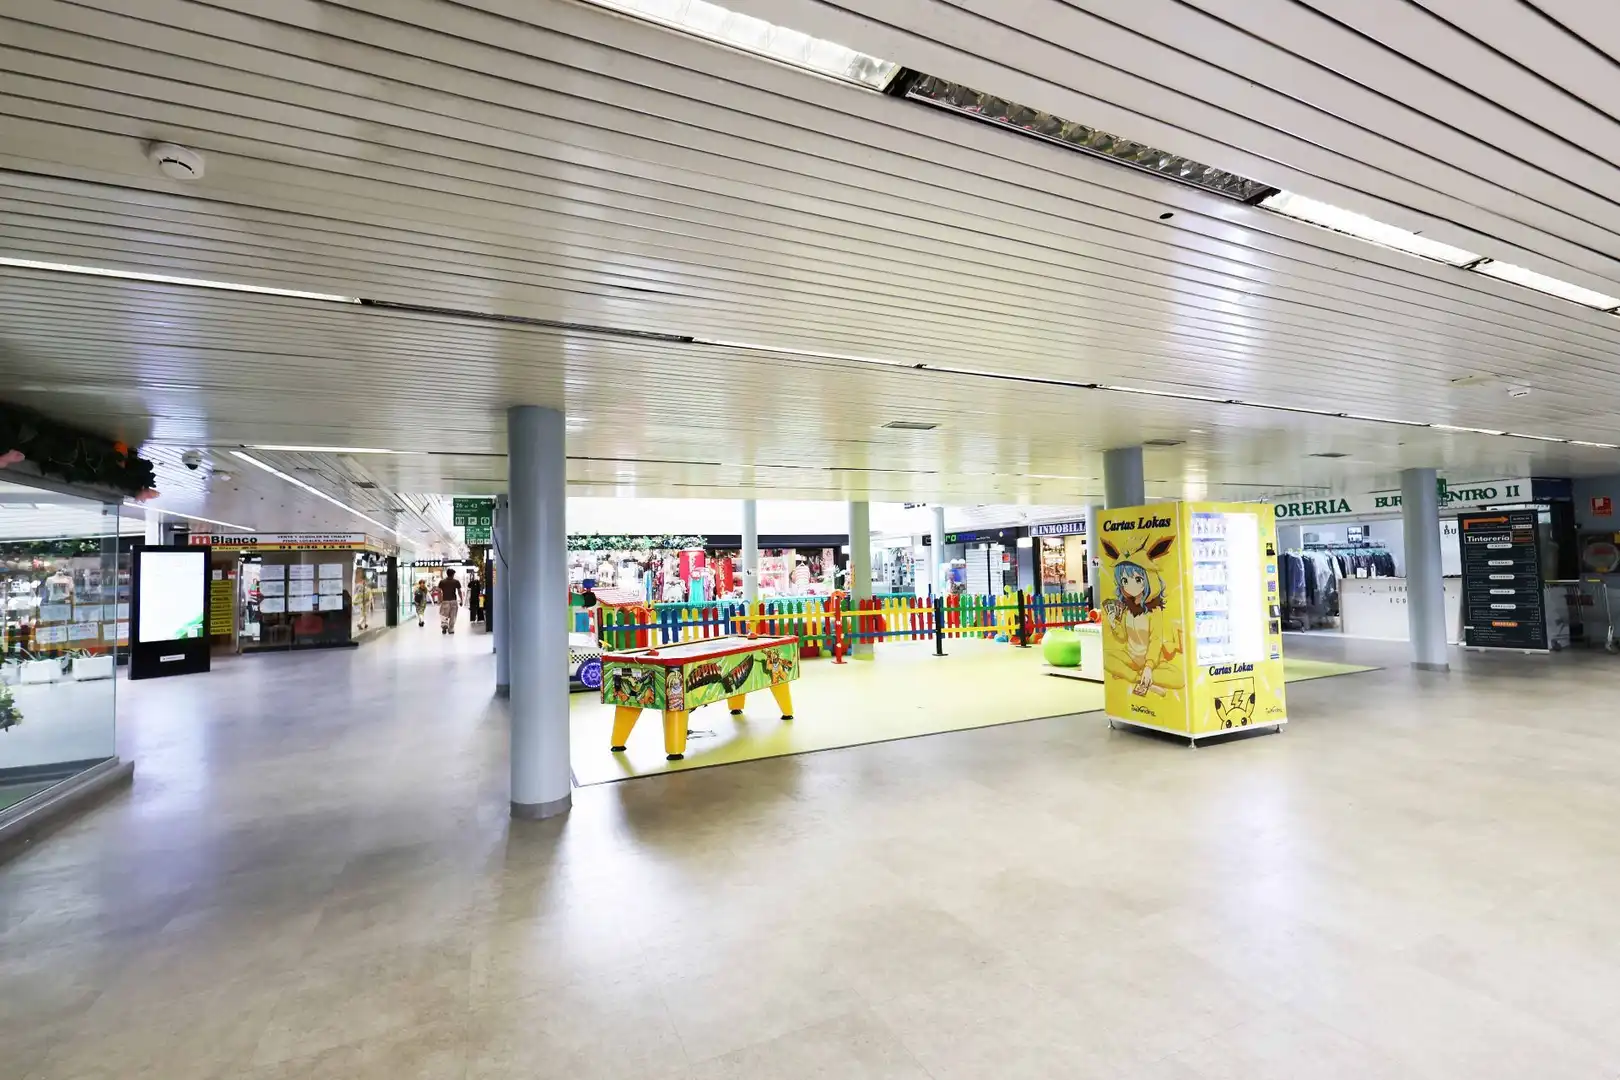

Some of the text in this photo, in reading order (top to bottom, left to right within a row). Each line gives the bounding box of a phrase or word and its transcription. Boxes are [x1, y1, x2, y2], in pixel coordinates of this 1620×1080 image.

[1505, 484, 1520, 498] II
[1275, 498, 1352, 518] ORERIA
[1103, 516, 1171, 532] Cartas Lokas
[1467, 534, 1510, 543] Tintorería
[1209, 662, 1254, 676] Cartas Lokas
